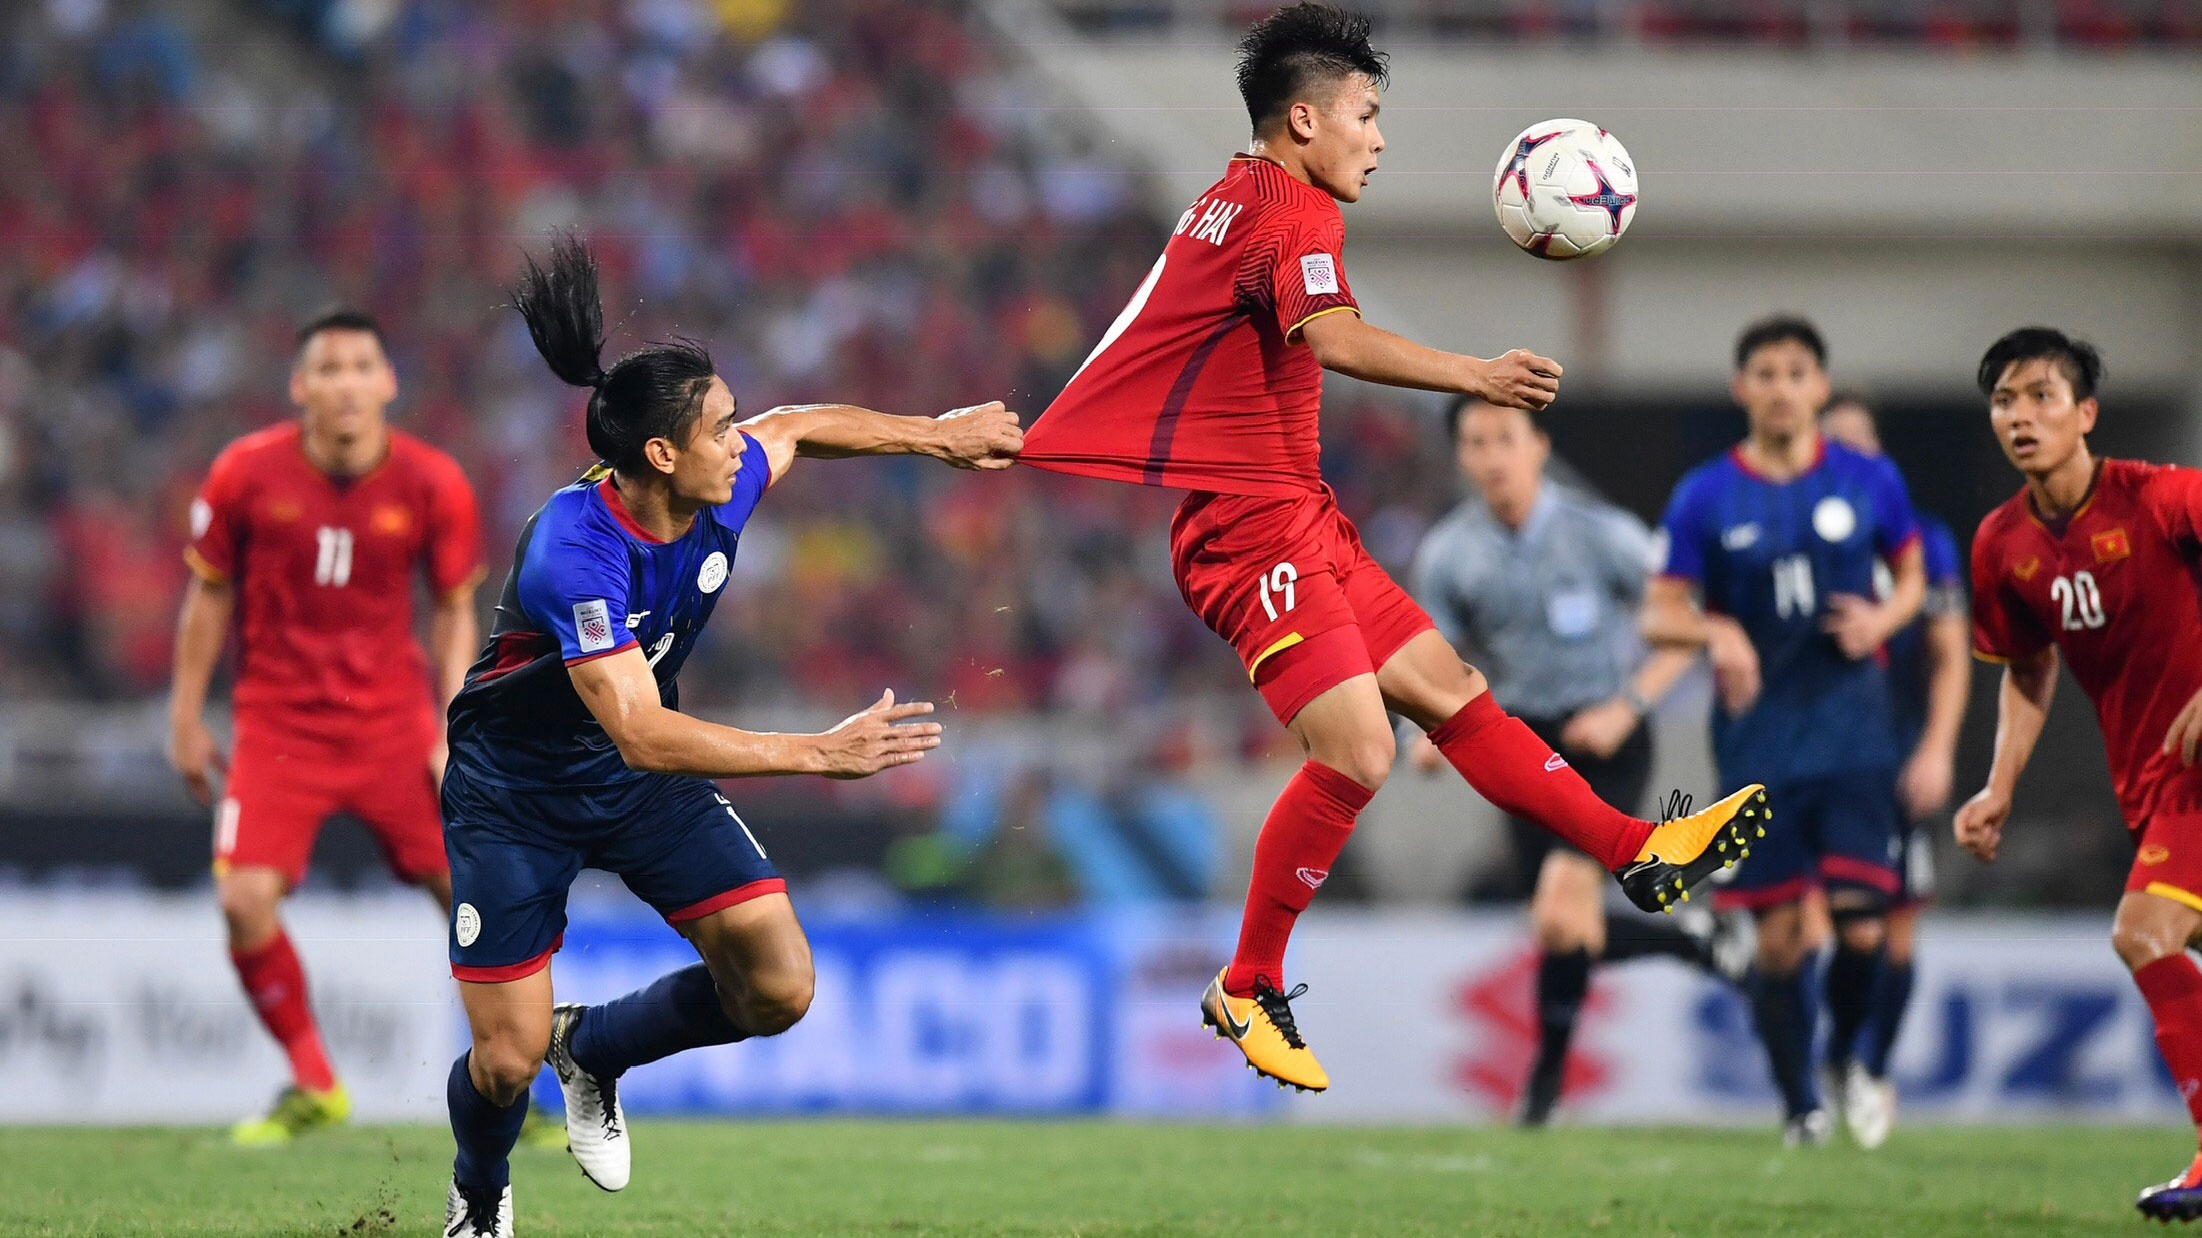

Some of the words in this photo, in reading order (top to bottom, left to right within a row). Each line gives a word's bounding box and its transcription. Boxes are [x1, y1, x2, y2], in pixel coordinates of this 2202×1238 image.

[315, 525, 354, 587] 11
[1259, 562, 1298, 622] 19
[2051, 570, 2106, 631] 20
